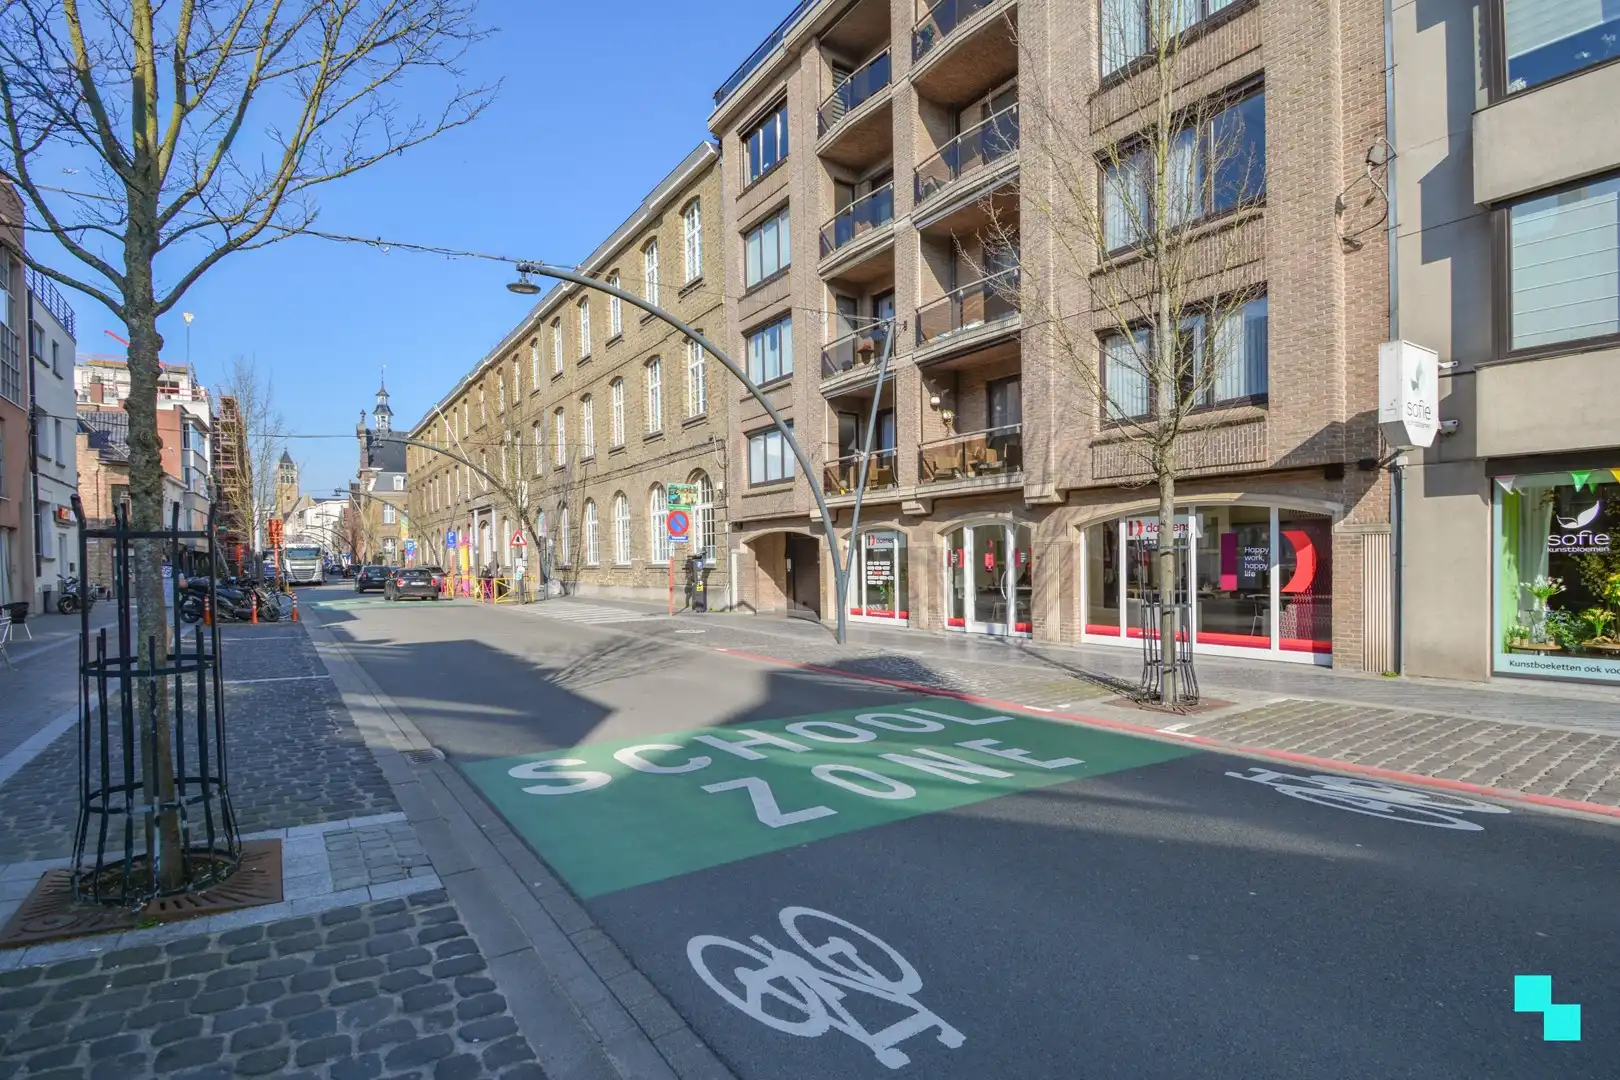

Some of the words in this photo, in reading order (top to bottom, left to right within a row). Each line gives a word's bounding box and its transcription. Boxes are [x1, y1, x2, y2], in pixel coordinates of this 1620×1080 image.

[1407, 400, 1431, 420] sofie
[1547, 530, 1610, 546] sofie
[1244, 546, 1269, 554] Happy
[1244, 562, 1269, 570] happy
[1509, 659, 1581, 672] Kunstboeketten
[1584, 665, 1604, 673] ook
[507, 708, 1015, 796] SCHOOL
[701, 738, 1086, 829] ZONE
